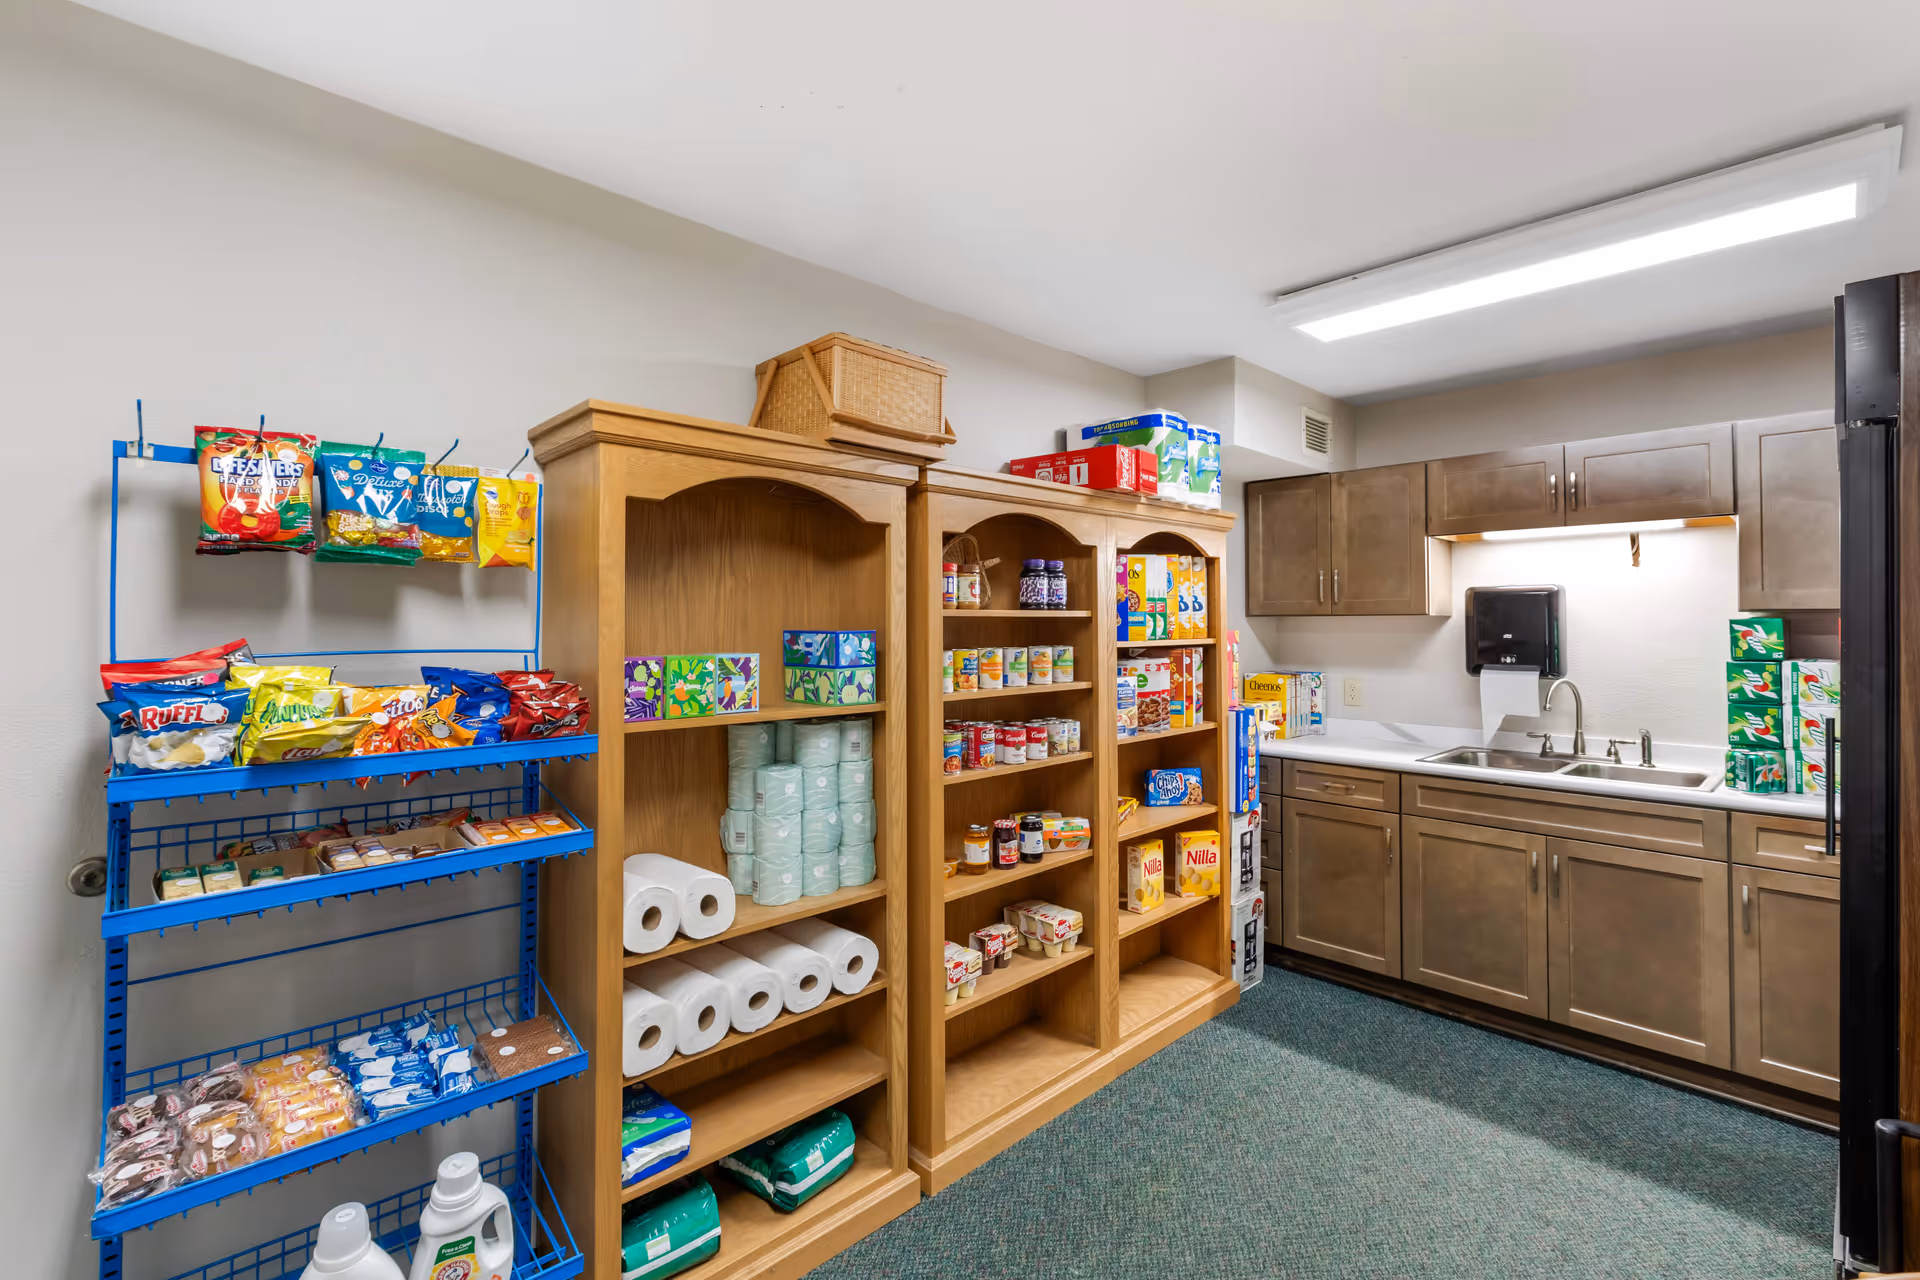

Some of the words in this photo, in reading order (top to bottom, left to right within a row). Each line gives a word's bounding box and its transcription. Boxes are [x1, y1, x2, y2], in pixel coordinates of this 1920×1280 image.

[1104, 419, 1139, 431] ABSORBING
[257, 478, 299, 488] CNDY
[353, 473, 404, 488] Deluxe
[1249, 680, 1282, 692] Cheerios
[139, 703, 229, 731] RUFFLS
[1157, 775, 1180, 790] Chips
[1186, 849, 1217, 865] Nilla
[1143, 857, 1162, 877] Nilla
[459, 1240, 472, 1249] Clear
